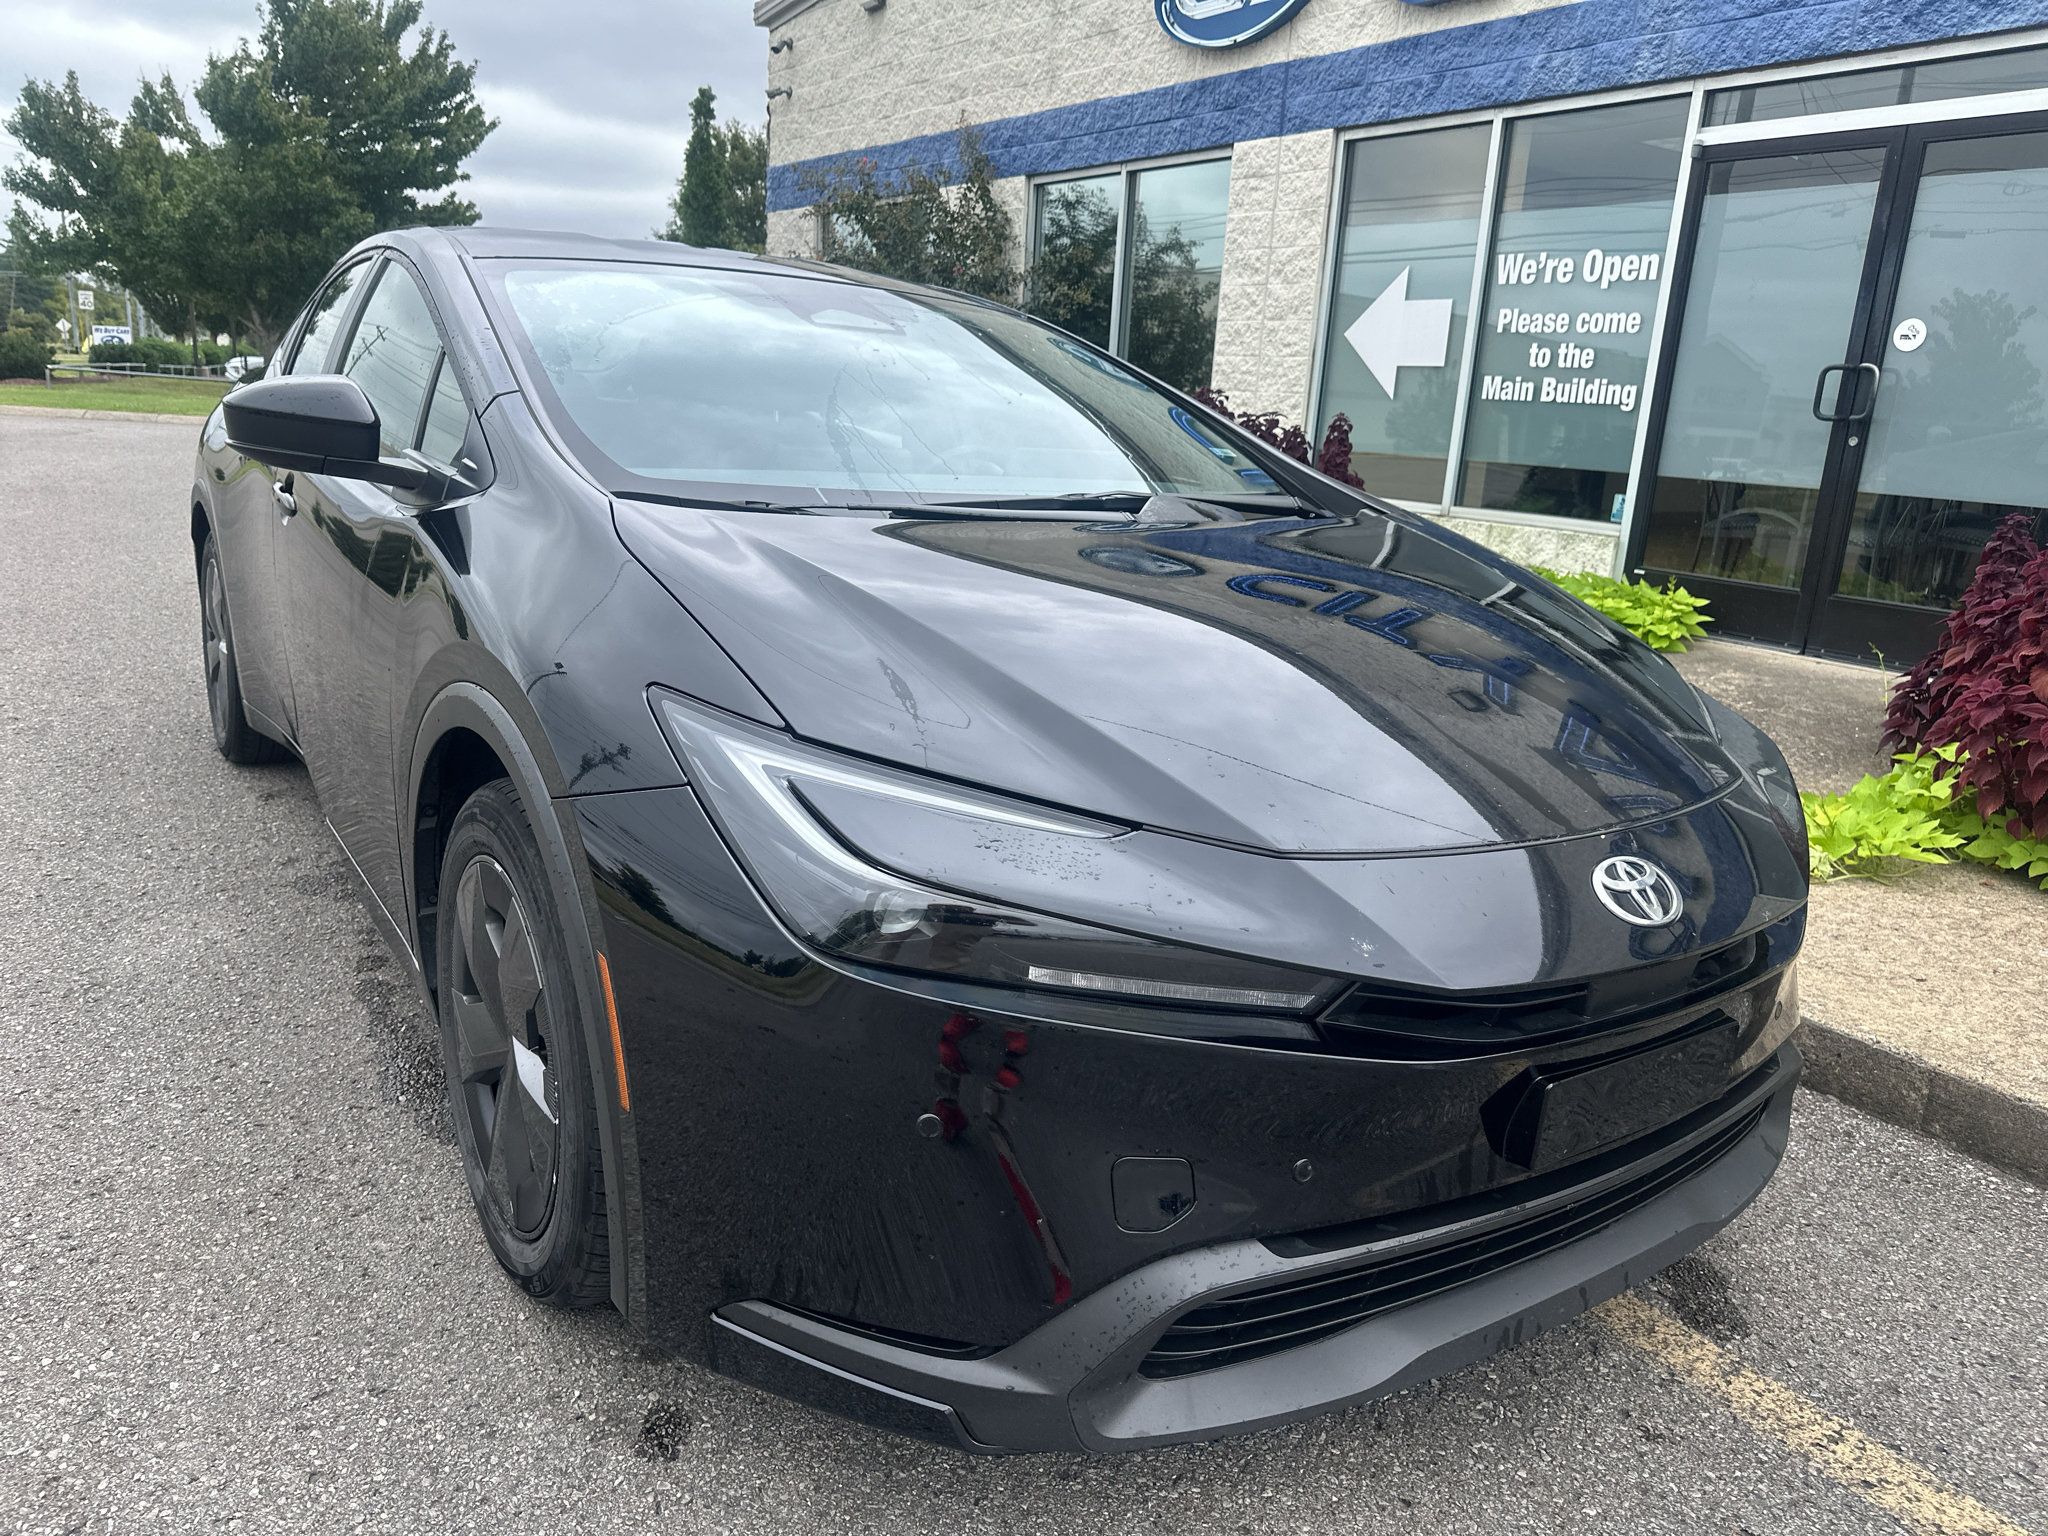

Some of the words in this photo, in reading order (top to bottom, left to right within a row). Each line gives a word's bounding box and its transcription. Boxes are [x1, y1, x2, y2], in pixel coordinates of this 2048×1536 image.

[1498, 252, 1574, 285] We're
[1582, 249, 1660, 289] Open
[81, 300, 93, 308] 40
[1497, 308, 1570, 334] Please
[1576, 312, 1641, 334] come
[1529, 343, 1551, 368] to
[1557, 343, 1595, 369] the
[1481, 375, 1535, 401] Main
[1540, 377, 1637, 412] Building
